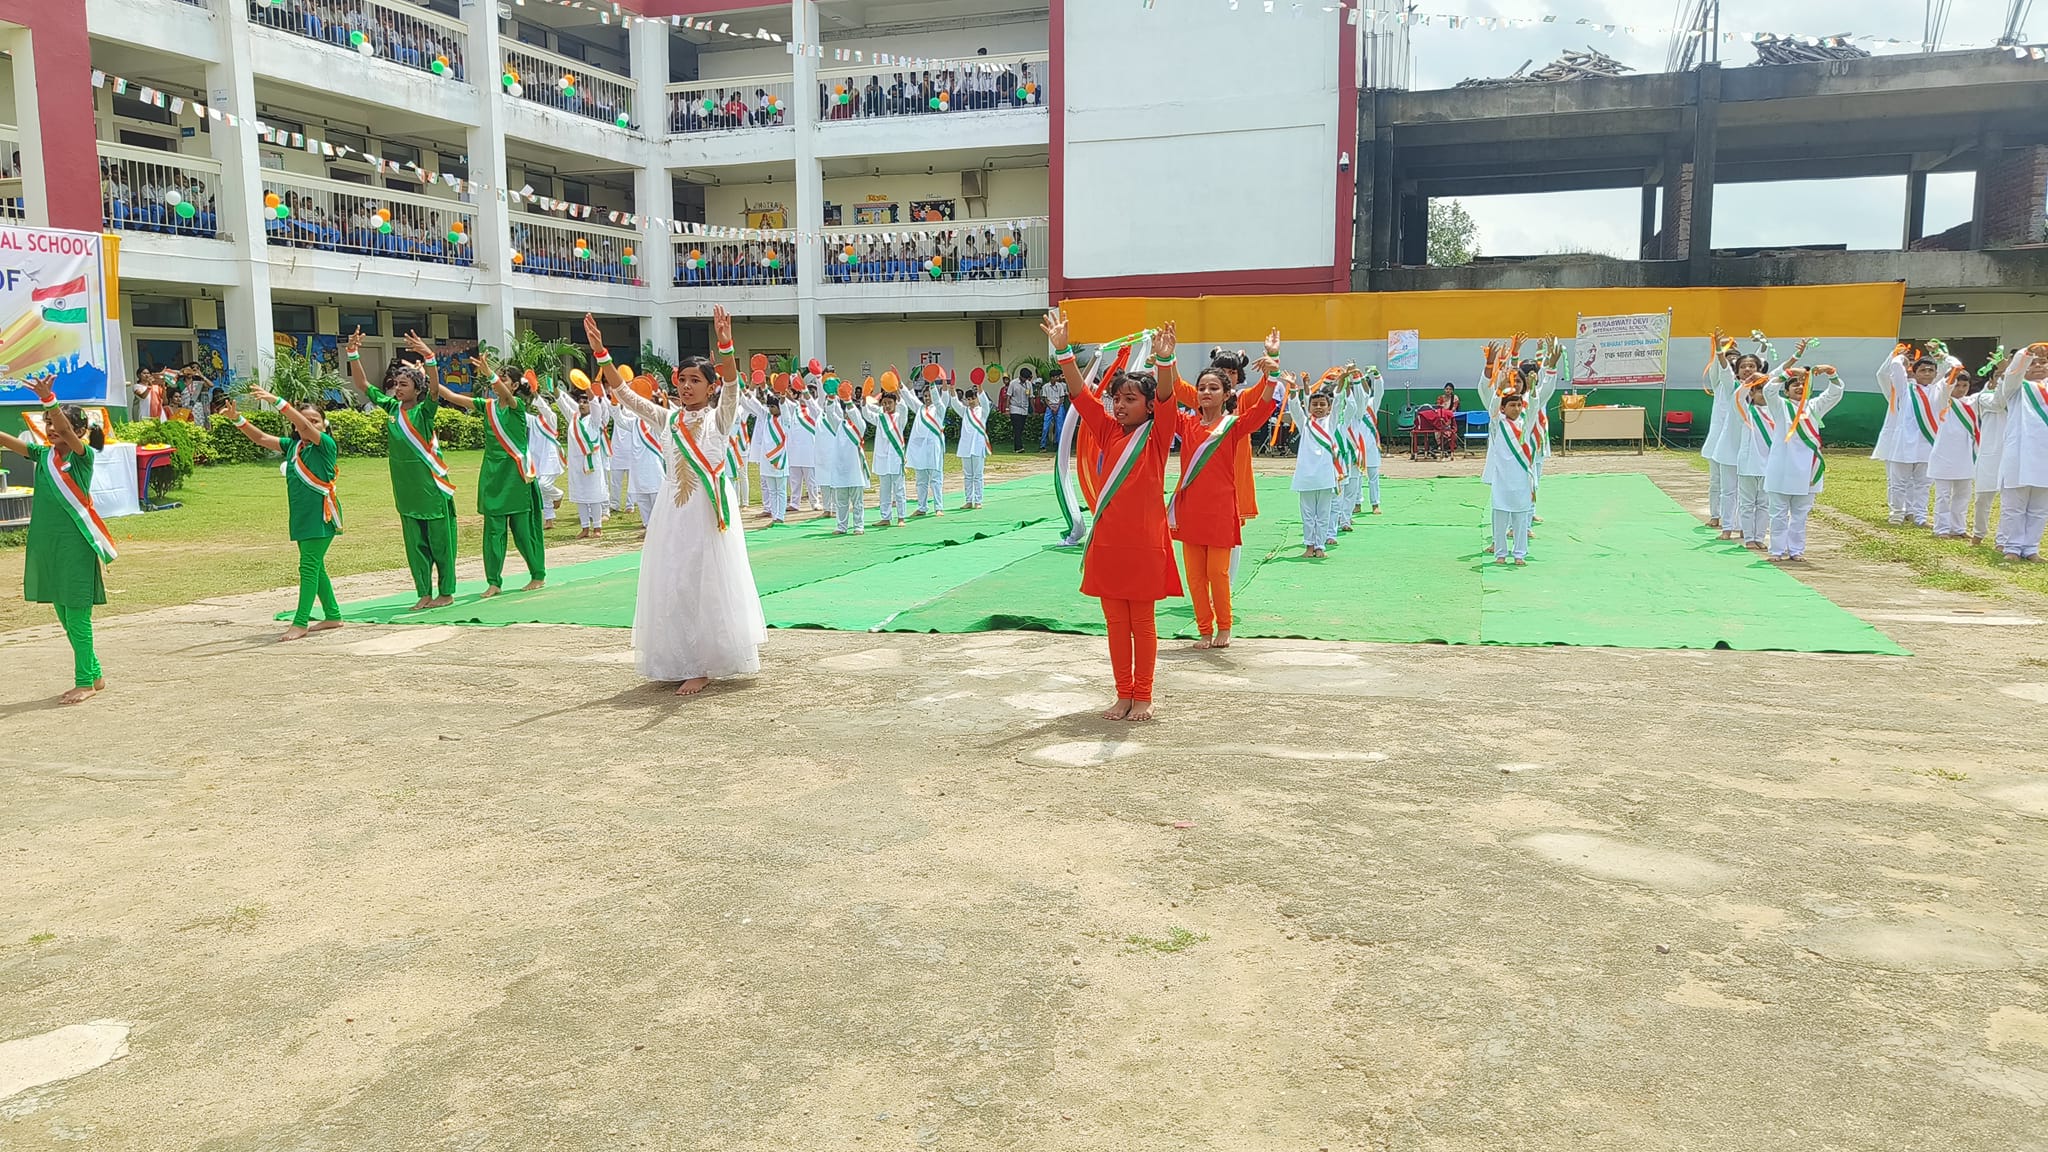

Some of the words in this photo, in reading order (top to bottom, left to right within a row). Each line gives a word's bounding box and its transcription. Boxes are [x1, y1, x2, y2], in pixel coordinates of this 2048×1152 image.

[27, 233, 93, 256] SCHOOL
[1593, 319, 1631, 328] SARASWATI
[1632, 317, 1649, 325] DEVI
[1616, 351, 1632, 359] भारत
[1647, 349, 1663, 357] भारत
